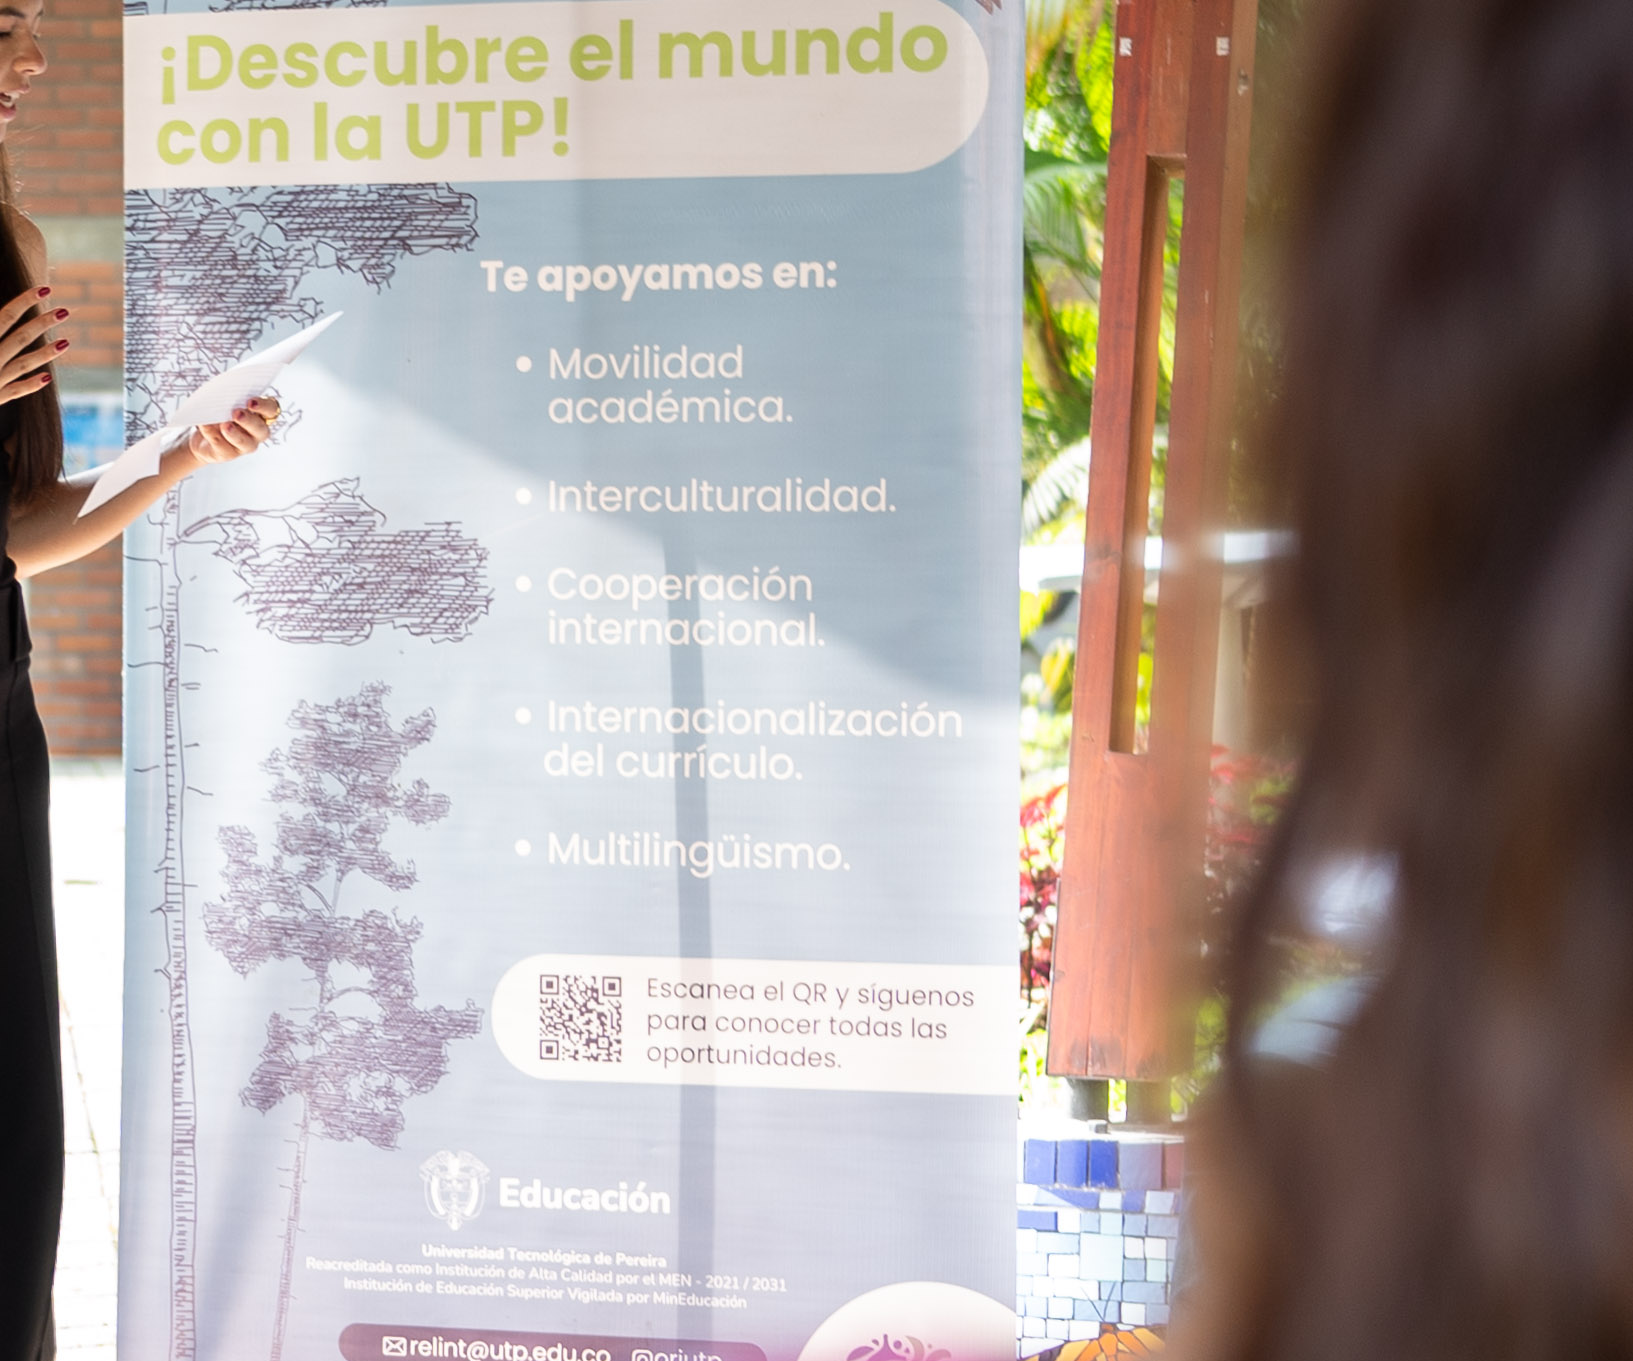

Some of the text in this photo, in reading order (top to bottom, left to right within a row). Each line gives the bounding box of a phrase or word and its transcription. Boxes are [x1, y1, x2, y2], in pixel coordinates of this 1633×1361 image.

[160, 11, 950, 106] ¡Descubre el mundo
[156, 95, 570, 166] con la UTP!
[480, 258, 838, 300] Te apoyamos en:
[548, 344, 743, 380] Movilidad
[548, 388, 794, 424] académica.
[548, 478, 897, 513] Interculturalidad.
[547, 566, 813, 611] Cooperación
[548, 610, 825, 647] internacional.
[547, 699, 963, 738] Internacionalización
[543, 742, 803, 781] del currículo.
[547, 831, 851, 879] Multilingüismo.
[647, 977, 975, 1010] Escanea el QR y síguenos
[647, 1011, 948, 1038] para conocer todas las
[646, 1043, 842, 1068] oportunidades.
[499, 1178, 670, 1213] Educación
[421, 1244, 666, 1266] Universidad Tecnológica de Pereira
[305, 1257, 392, 1272] Reacreditada
[396, 1263, 432, 1274] como
[435, 1263, 505, 1277] Institución
[508, 1264, 525, 1278] de
[528, 1266, 557, 1279] Alta
[560, 1269, 612, 1283] Calidad
[615, 1272, 639, 1285] por
[641, 1271, 655, 1284] el
[658, 1272, 691, 1286] MEN
[705, 1274, 738, 1288] 2021
[742, 1275, 750, 1290] /
[752, 1276, 786, 1291] 2031
[343, 1277, 747, 1307] Institución de Educación Superior Vigilada por MinEducación
